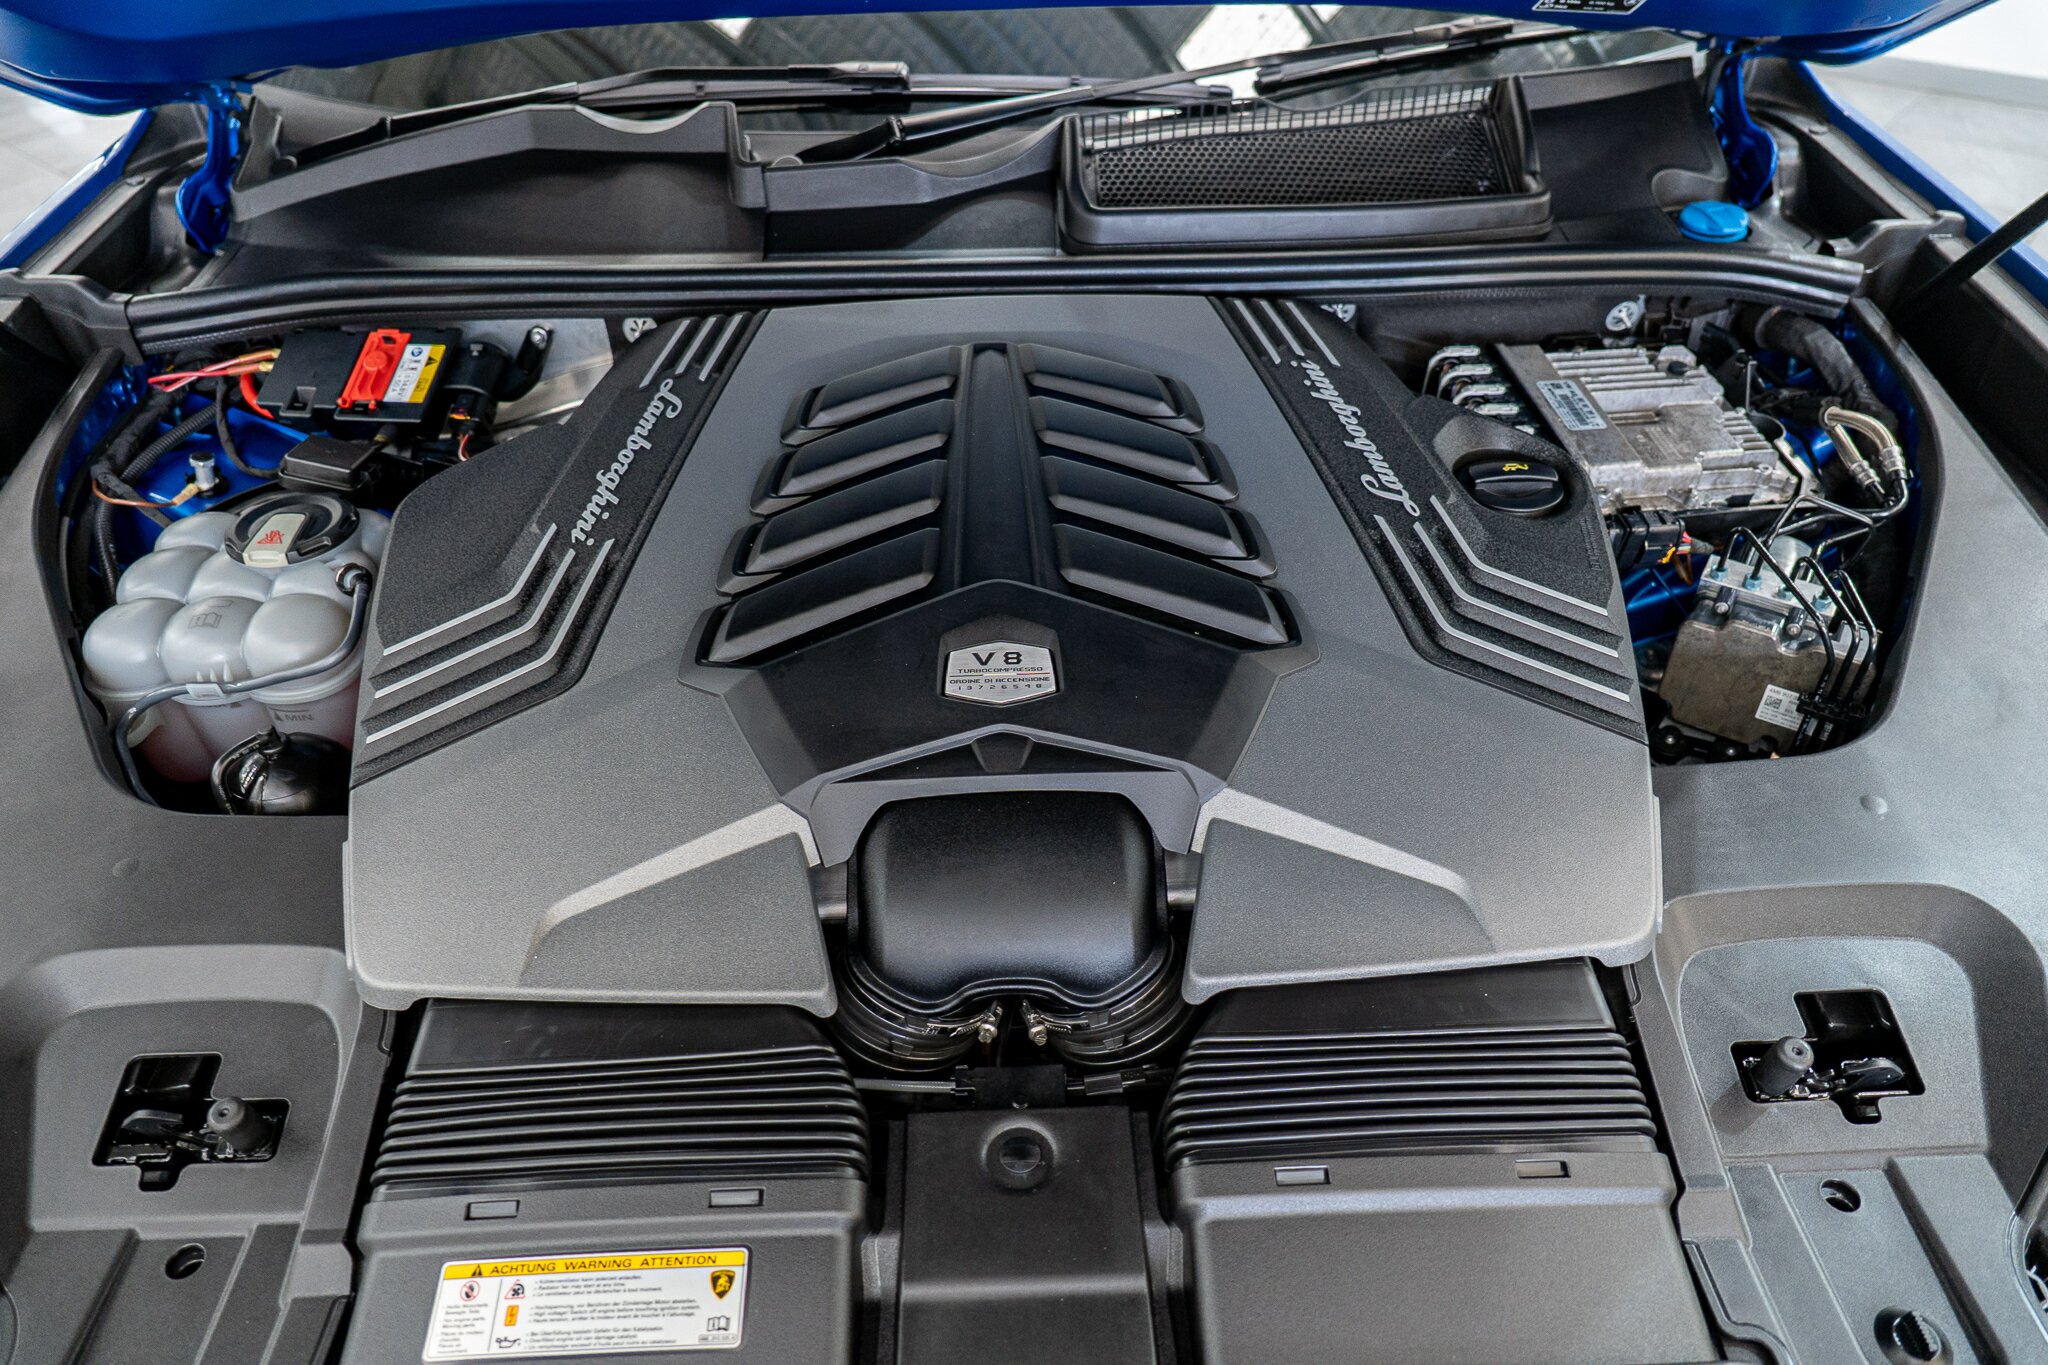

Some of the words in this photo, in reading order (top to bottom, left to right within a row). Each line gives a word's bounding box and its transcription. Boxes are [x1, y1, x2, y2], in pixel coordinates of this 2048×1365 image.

[1290, 359, 1420, 517] Lamborghini
[571, 378, 683, 546] Lamborghini
[972, 652, 1022, 666] V8
[284, 712, 314, 722] MIN
[489, 1261, 557, 1275] ACHTUNG
[563, 1258, 633, 1271] WARNING
[639, 1255, 719, 1267] ATTENTION
